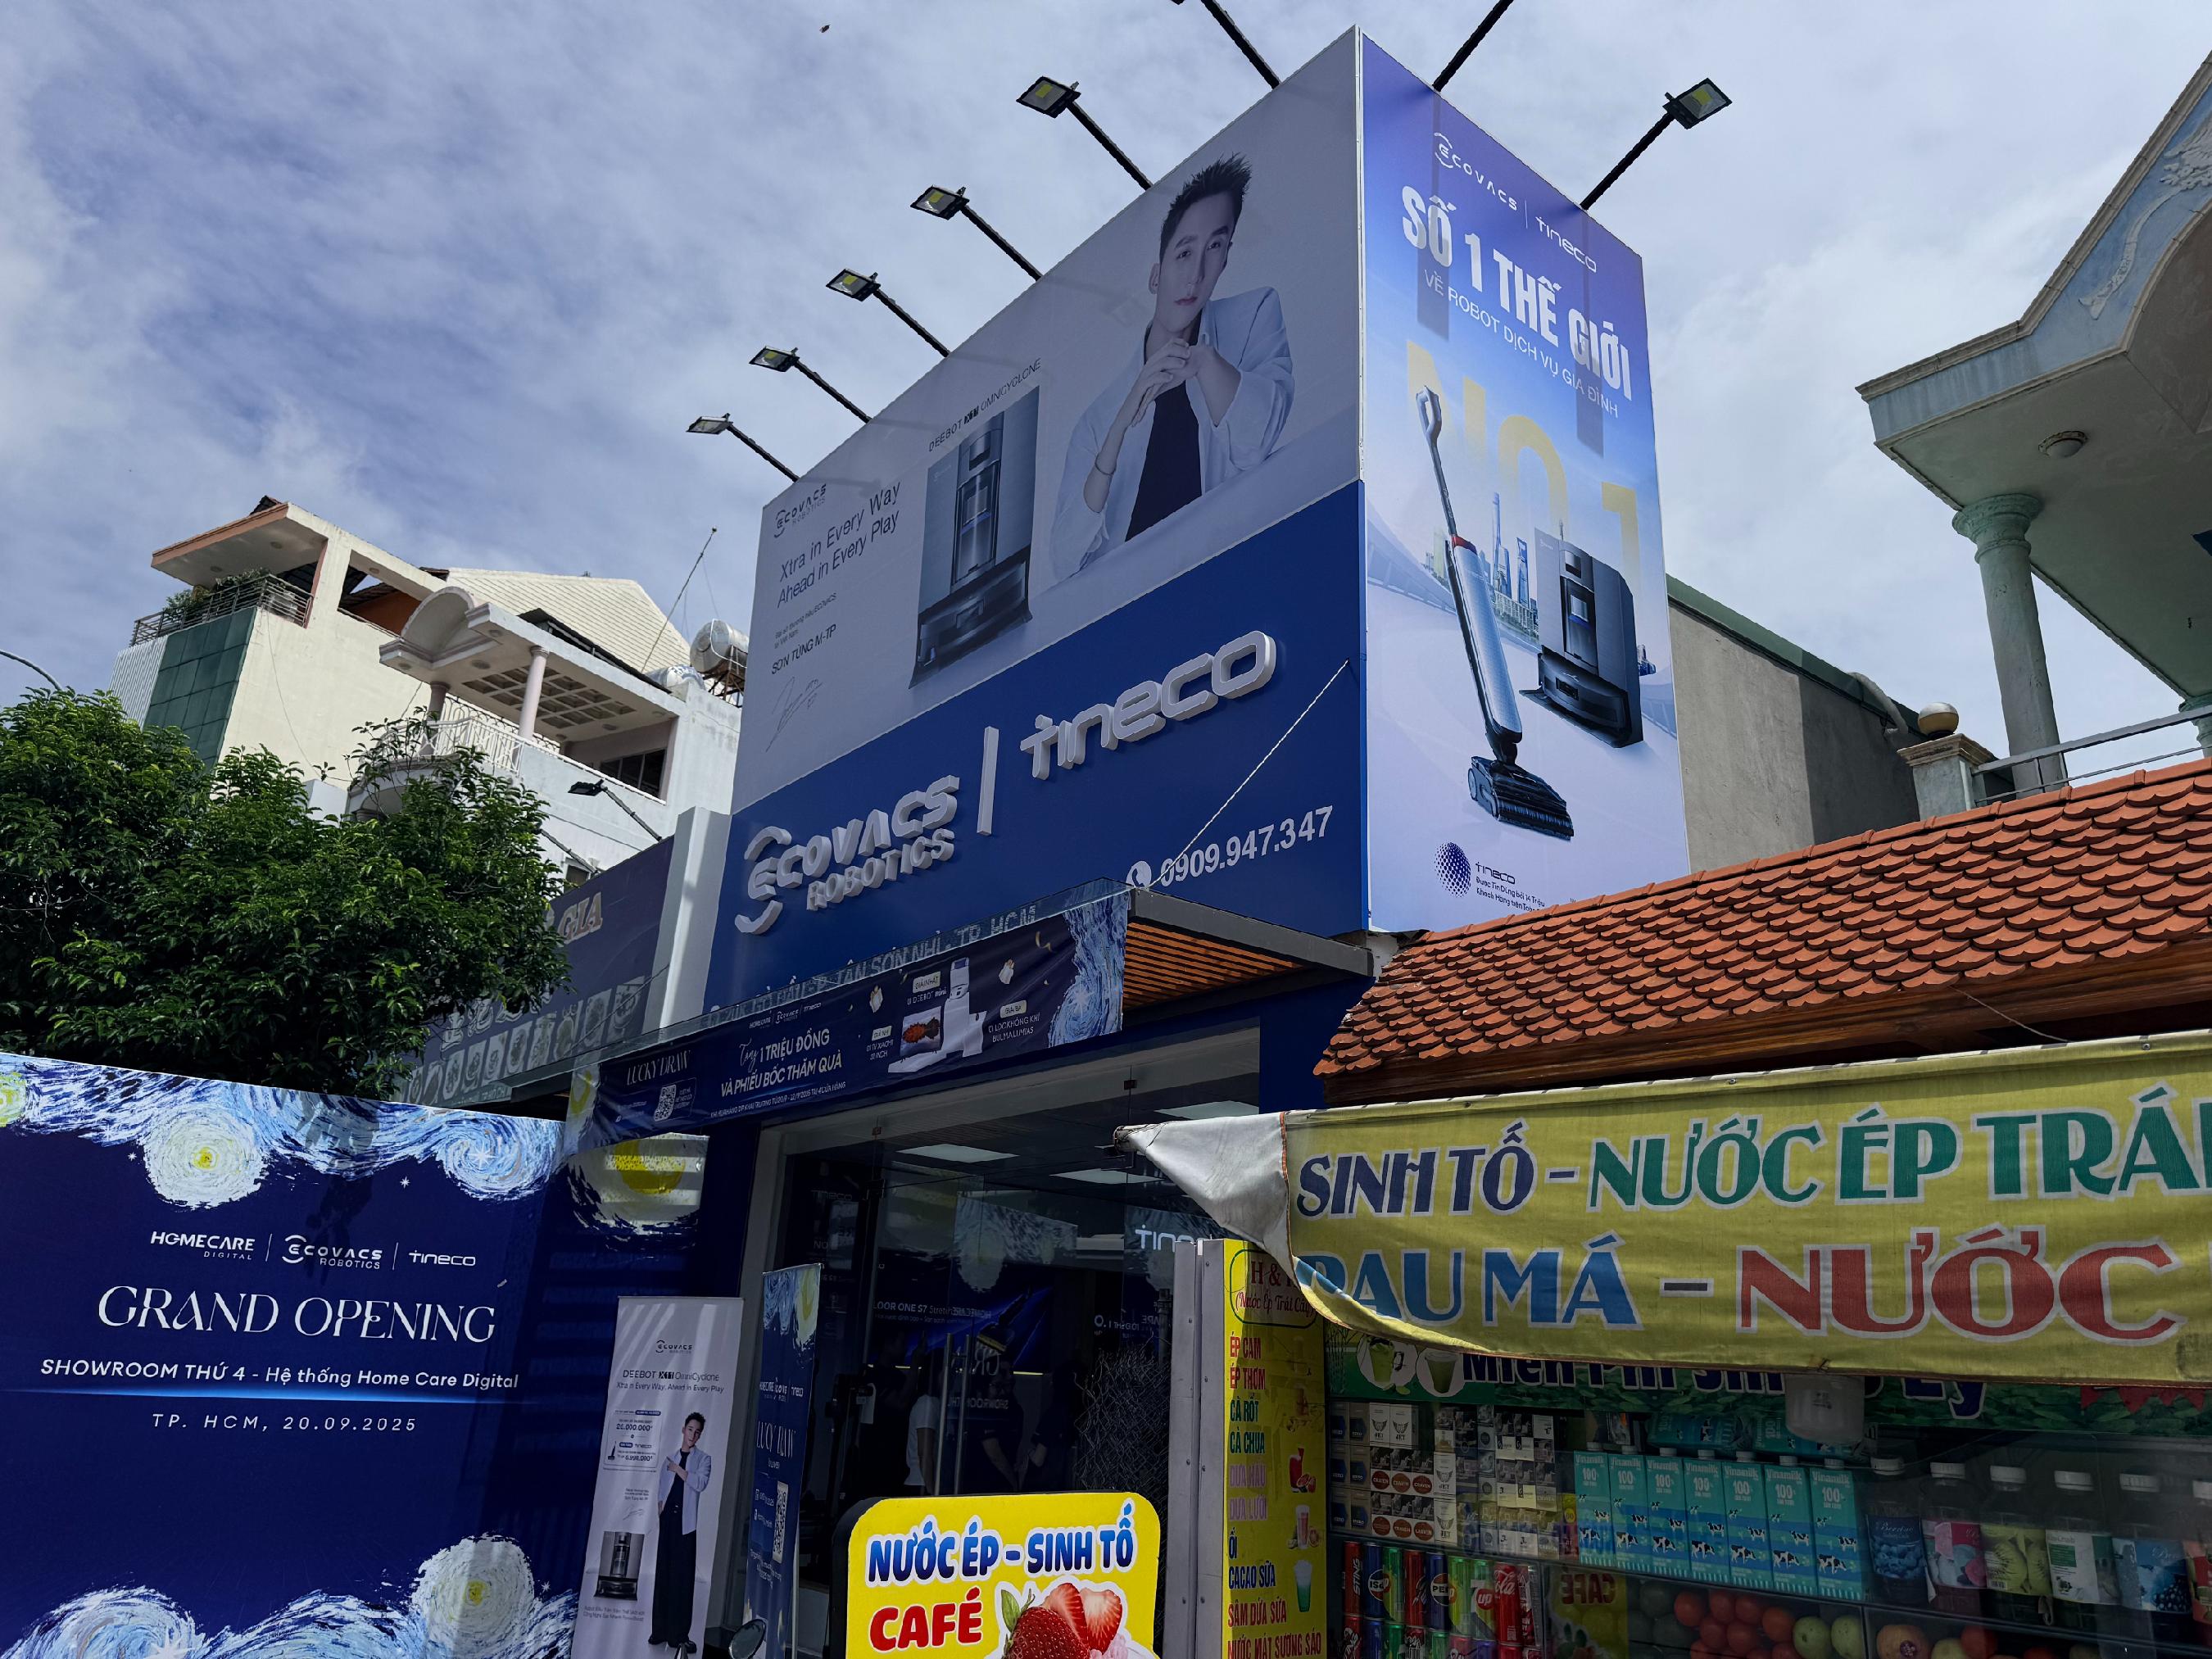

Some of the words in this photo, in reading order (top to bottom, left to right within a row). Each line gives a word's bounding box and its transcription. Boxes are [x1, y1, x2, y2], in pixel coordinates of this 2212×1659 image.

[1434, 132, 1517, 211] ECOVACS
[1402, 185, 1457, 267] SỐ
[1464, 233, 1483, 292] 1
[1493, 248, 1563, 347] THẾ
[1568, 308, 1632, 401] GIỚI
[1424, 268, 1444, 297] VỀ
[1448, 286, 1500, 333] ROBOT
[1504, 325, 1537, 361] DỊCH
[1540, 350, 1559, 377] VỤ
[1562, 368, 1584, 392] GIA
[1588, 385, 1618, 419] ĐÌNH
[929, 419, 963, 451] DEEBOT
[774, 483, 827, 539] ECOVACS
[779, 553, 805, 582] Xtra
[810, 541, 821, 561] in
[827, 509, 864, 549] Every
[869, 482, 900, 515] Way
[777, 568, 815, 609] Ahead
[818, 561, 828, 580] in
[832, 535, 867, 571] Every
[872, 510, 900, 542] Play
[815, 623, 836, 650] M-TP
[735, 774, 960, 935] ECOVACS
[1159, 807, 1334, 888] 0909.947.347
[806, 827, 955, 912] ROBOTICS
[557, 891, 603, 945] GIA
[765, 1037, 794, 1062] TRIỆU
[796, 1027, 831, 1053] ĐỒNG
[721, 1077, 733, 1097] VÀ
[1297, 1154, 1436, 1218] SINH
[1447, 1121, 1535, 1212] TỐ
[1589, 1115, 1820, 1208] NƯỚC
[1839, 1108, 1958, 1199] ÉP
[202, 1250, 252, 1261] DIGITAL
[320, 1258, 381, 1270] ROBOTICS
[281, 1234, 383, 1264] ECOVACS
[1484, 1234, 1639, 1326] MÁ
[1741, 1229, 2178, 1340] NƯỚC
[98, 1285, 279, 1335] GRAND
[294, 1296, 496, 1344] OPENING
[1230, 1330, 1240, 1358] ÉP
[1243, 1337, 1261, 1359] CAM
[40, 1358, 178, 1380] SHOWROOM
[185, 1359, 229, 1381] THỨ
[233, 1367, 246, 1381] 4
[265, 1366, 292, 1385] Hệ
[297, 1363, 352, 1388] thống
[357, 1370, 410, 1388] Home
[415, 1371, 458, 1388] Care
[463, 1371, 519, 1390] Digital
[623, 1370, 656, 1380] DEEBOT
[635, 1382, 650, 1391] Every
[693, 1385, 710, 1393] Every
[711, 1385, 725, 1394] Play
[1230, 1362, 1240, 1389] ÉP
[152, 1414, 188, 1429] TP.
[203, 1415, 270, 1432] HCM,
[283, 1416, 417, 1432] 20.09.2025
[1230, 1395, 1241, 1421] CÀ
[1244, 1392, 1259, 1422] RỐT
[1230, 1426, 1241, 1454] CÀ
[1244, 1430, 1265, 1454] CHUA
[868, 1521, 955, 1582] NƯỚC
[962, 1521, 999, 1576] ÉP
[1027, 1530, 1092, 1574] SINH
[1099, 1503, 1134, 1569] TỐ
[1229, 1566, 1257, 1589] CACAO
[870, 1587, 982, 1652] CAFÉ
[1228, 1599, 1248, 1627] SÂM
[1255, 1633, 1271, 1659] MÁT
[1275, 1632, 1303, 1659] SƯƠNG
[1305, 1627, 1321, 1656] SÁO
